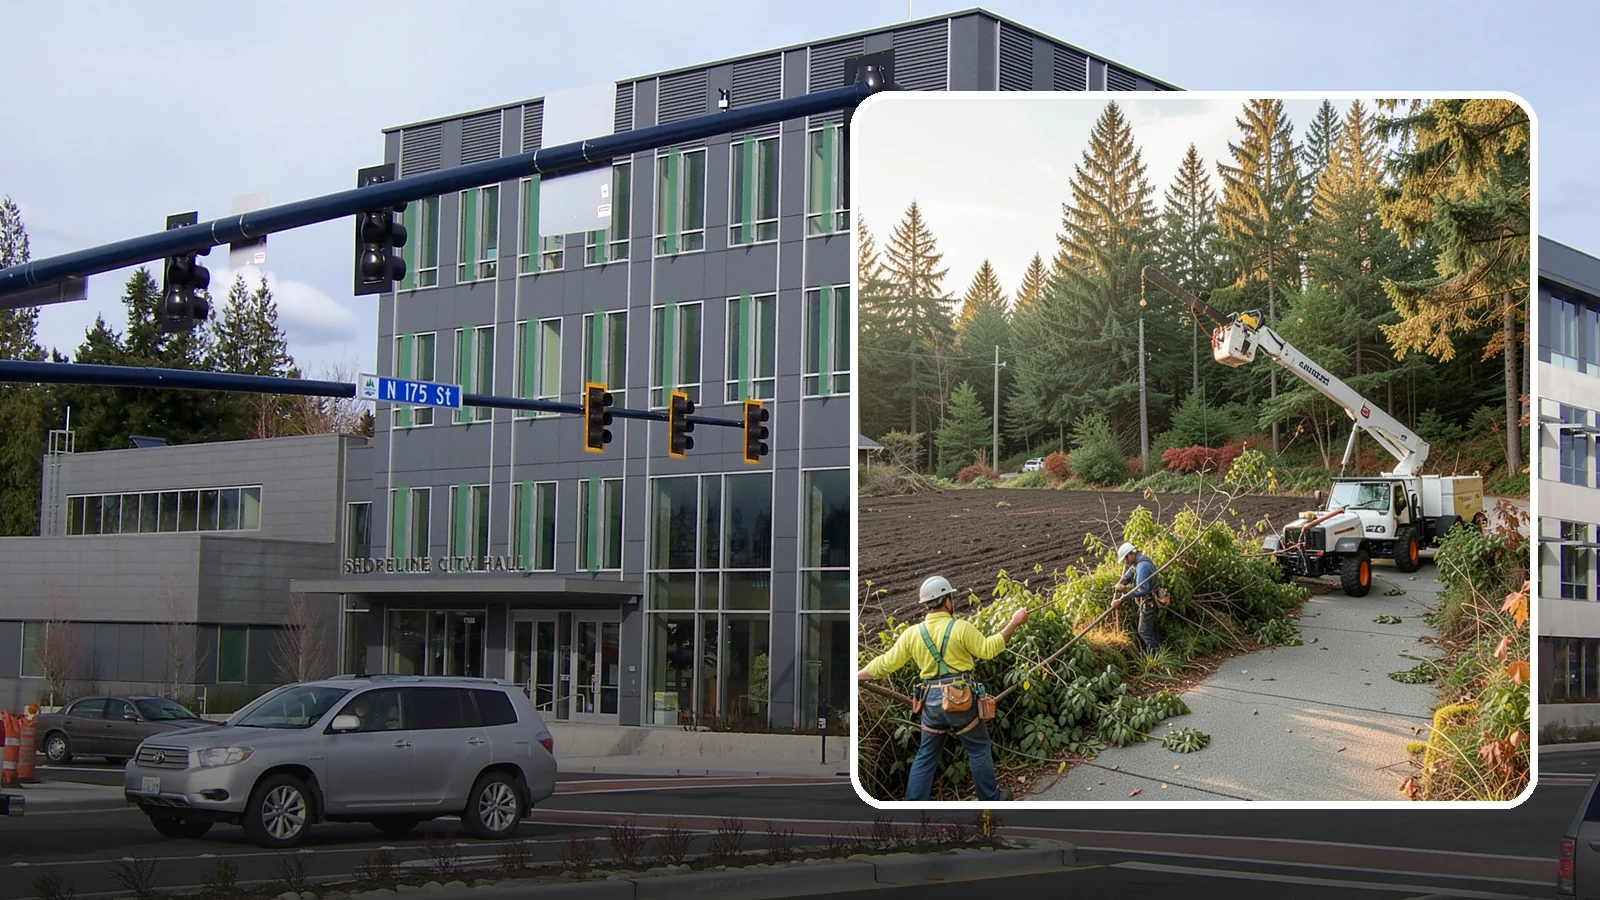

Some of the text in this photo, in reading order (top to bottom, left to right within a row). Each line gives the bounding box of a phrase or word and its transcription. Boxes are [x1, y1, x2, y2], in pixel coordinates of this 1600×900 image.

[387, 380, 452, 406] N 175 St
[344, 555, 525, 574] SHORELINE CITY HALL
